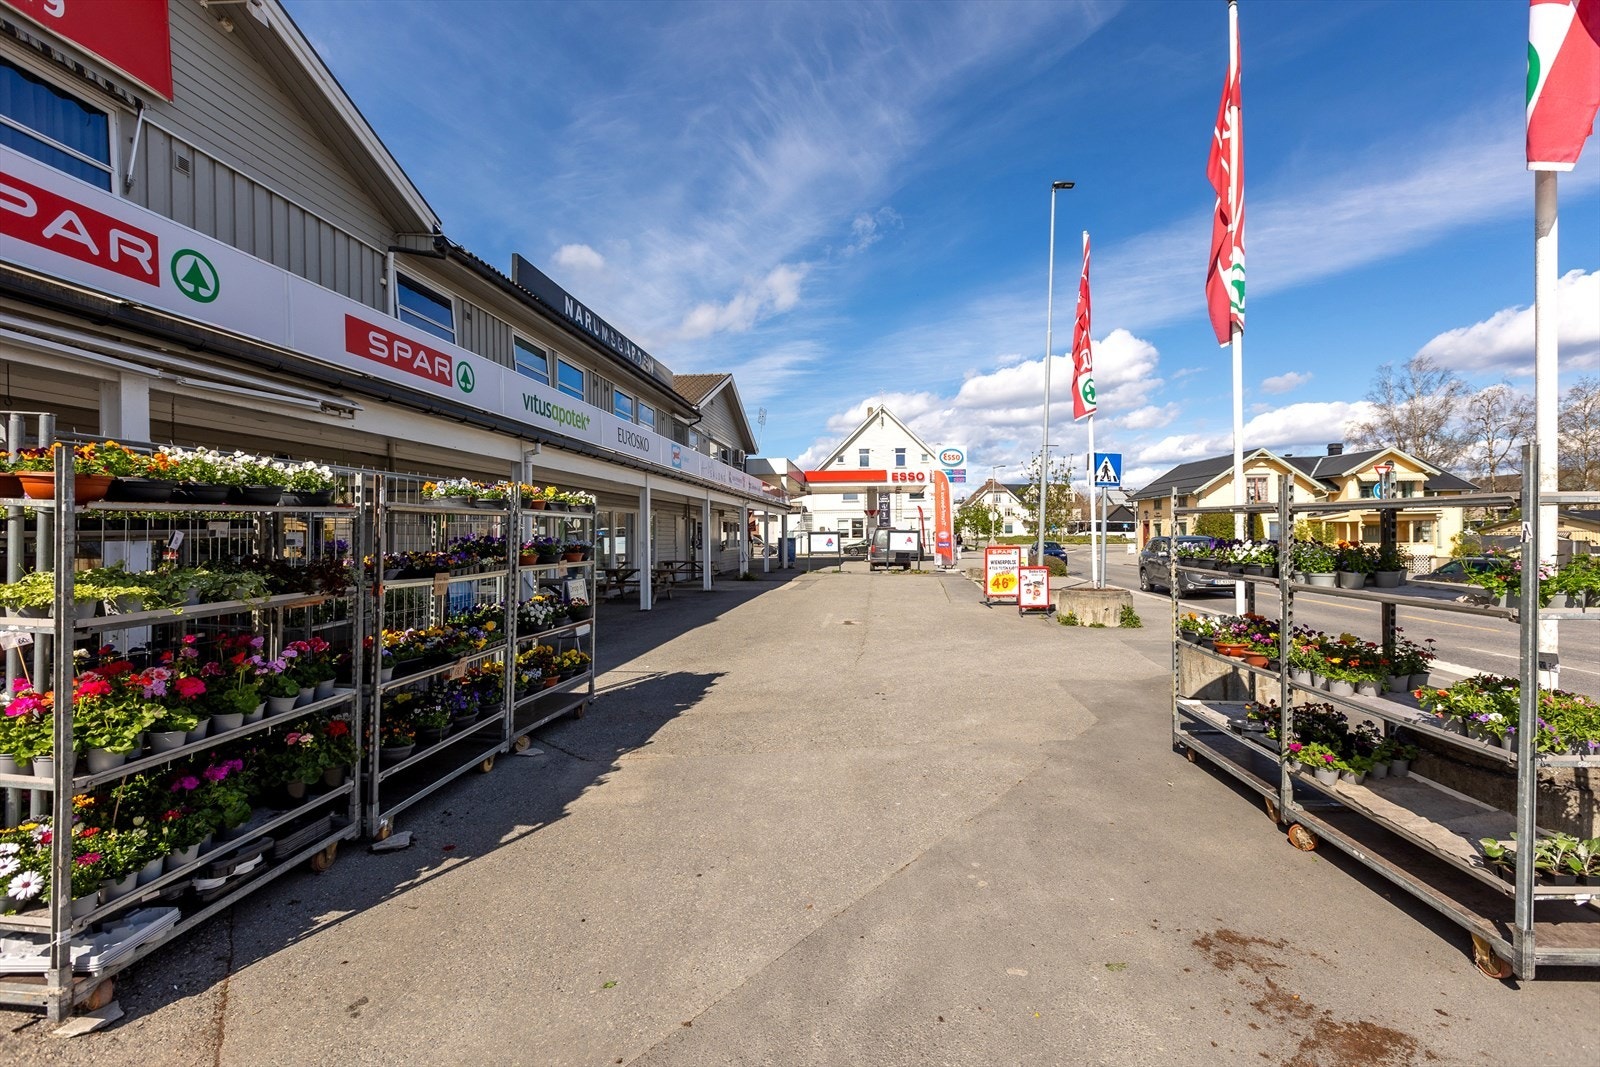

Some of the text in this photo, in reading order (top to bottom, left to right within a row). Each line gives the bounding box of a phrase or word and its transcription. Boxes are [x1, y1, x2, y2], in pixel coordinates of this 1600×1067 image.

[368, 330, 451, 381] SPAR
[617, 427, 650, 452] EUROSKO
[892, 471, 925, 482] ESSO
[992, 577, 1009, 589] 46
